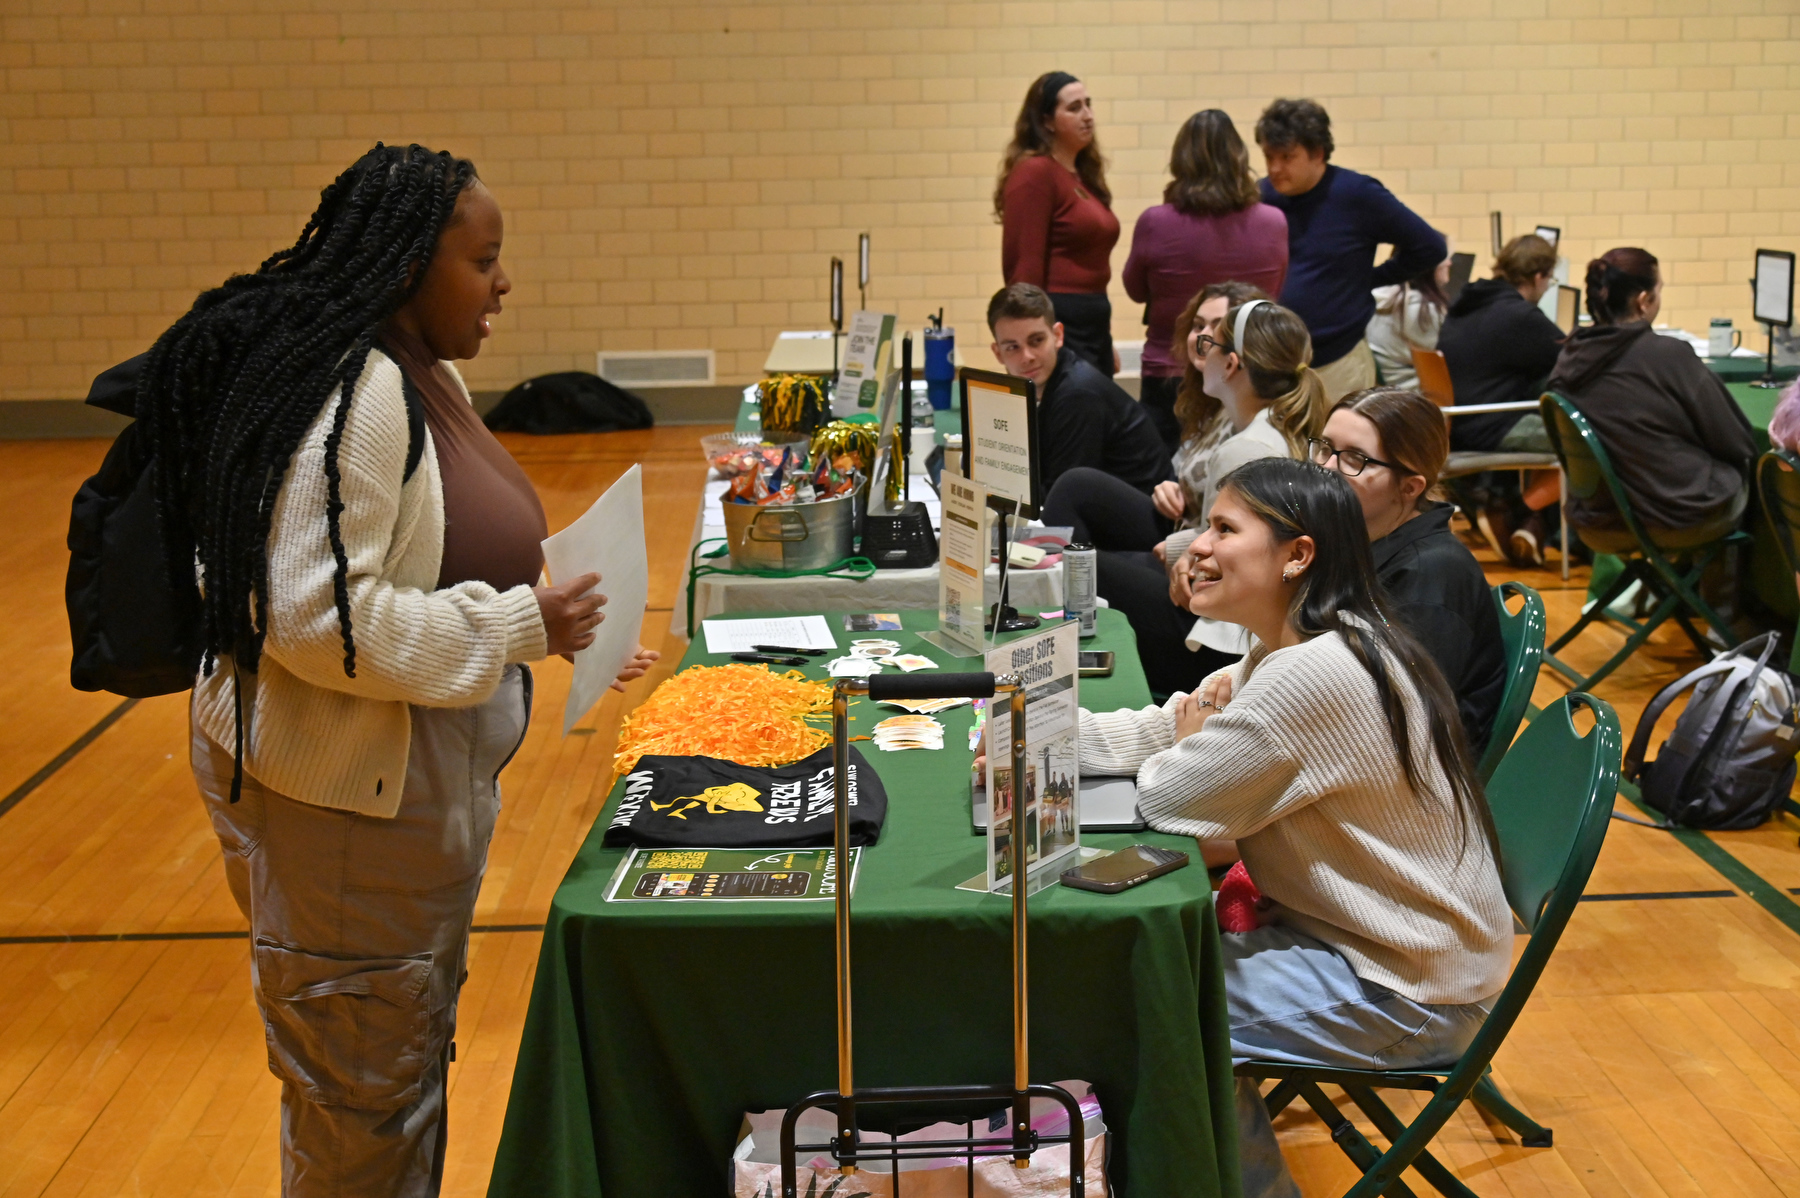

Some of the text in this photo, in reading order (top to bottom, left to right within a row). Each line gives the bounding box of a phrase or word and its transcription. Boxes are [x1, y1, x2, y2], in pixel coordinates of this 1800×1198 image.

[993, 418, 1009, 432] SOFE
[977, 437, 1027, 457] STUDENT ORIENTATION
[984, 457, 1000, 469] FAMILY
[1011, 636, 1055, 670] Other SOFE
[764, 780, 801, 825] FRIENDS
